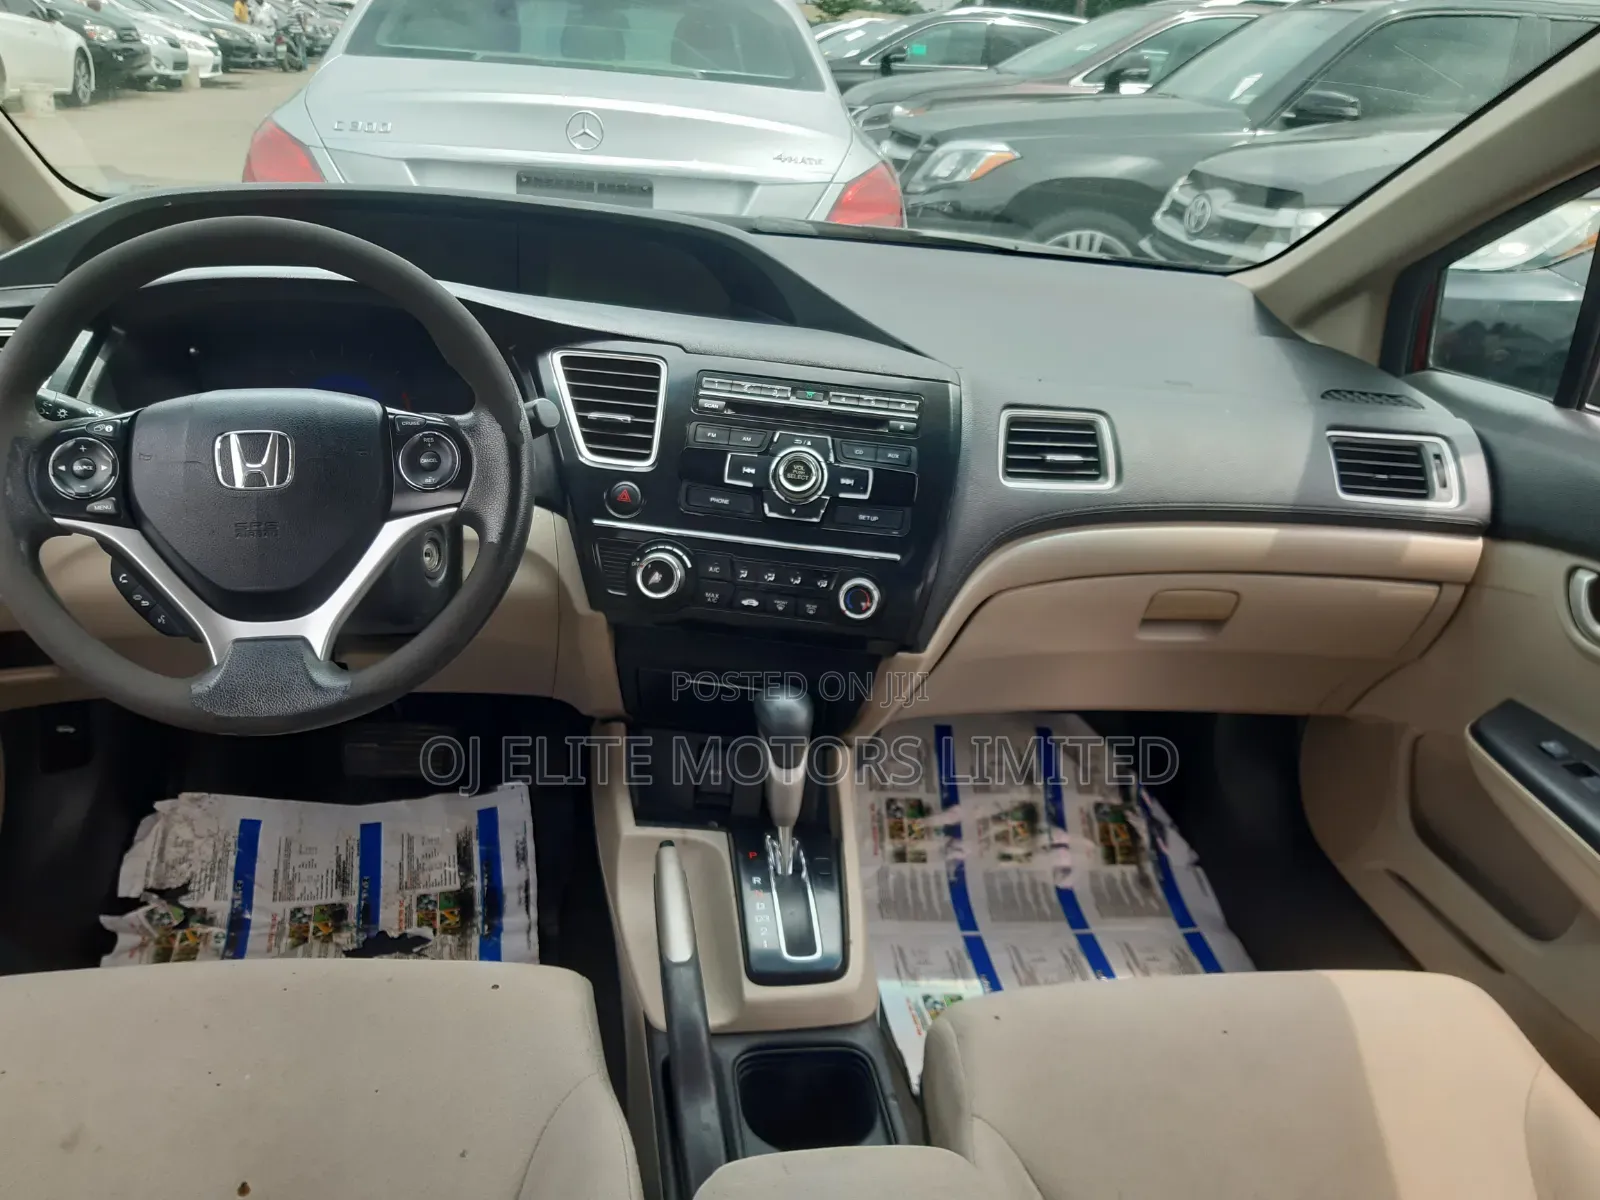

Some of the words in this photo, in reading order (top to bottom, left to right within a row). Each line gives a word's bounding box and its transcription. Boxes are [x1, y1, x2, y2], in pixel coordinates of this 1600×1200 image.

[786, 472, 809, 481] SELECT
[709, 497, 730, 505] PHONE
[748, 851, 757, 859] P
[752, 876, 762, 884] R
[756, 902, 766, 911] D
[761, 927, 768, 936] 2
